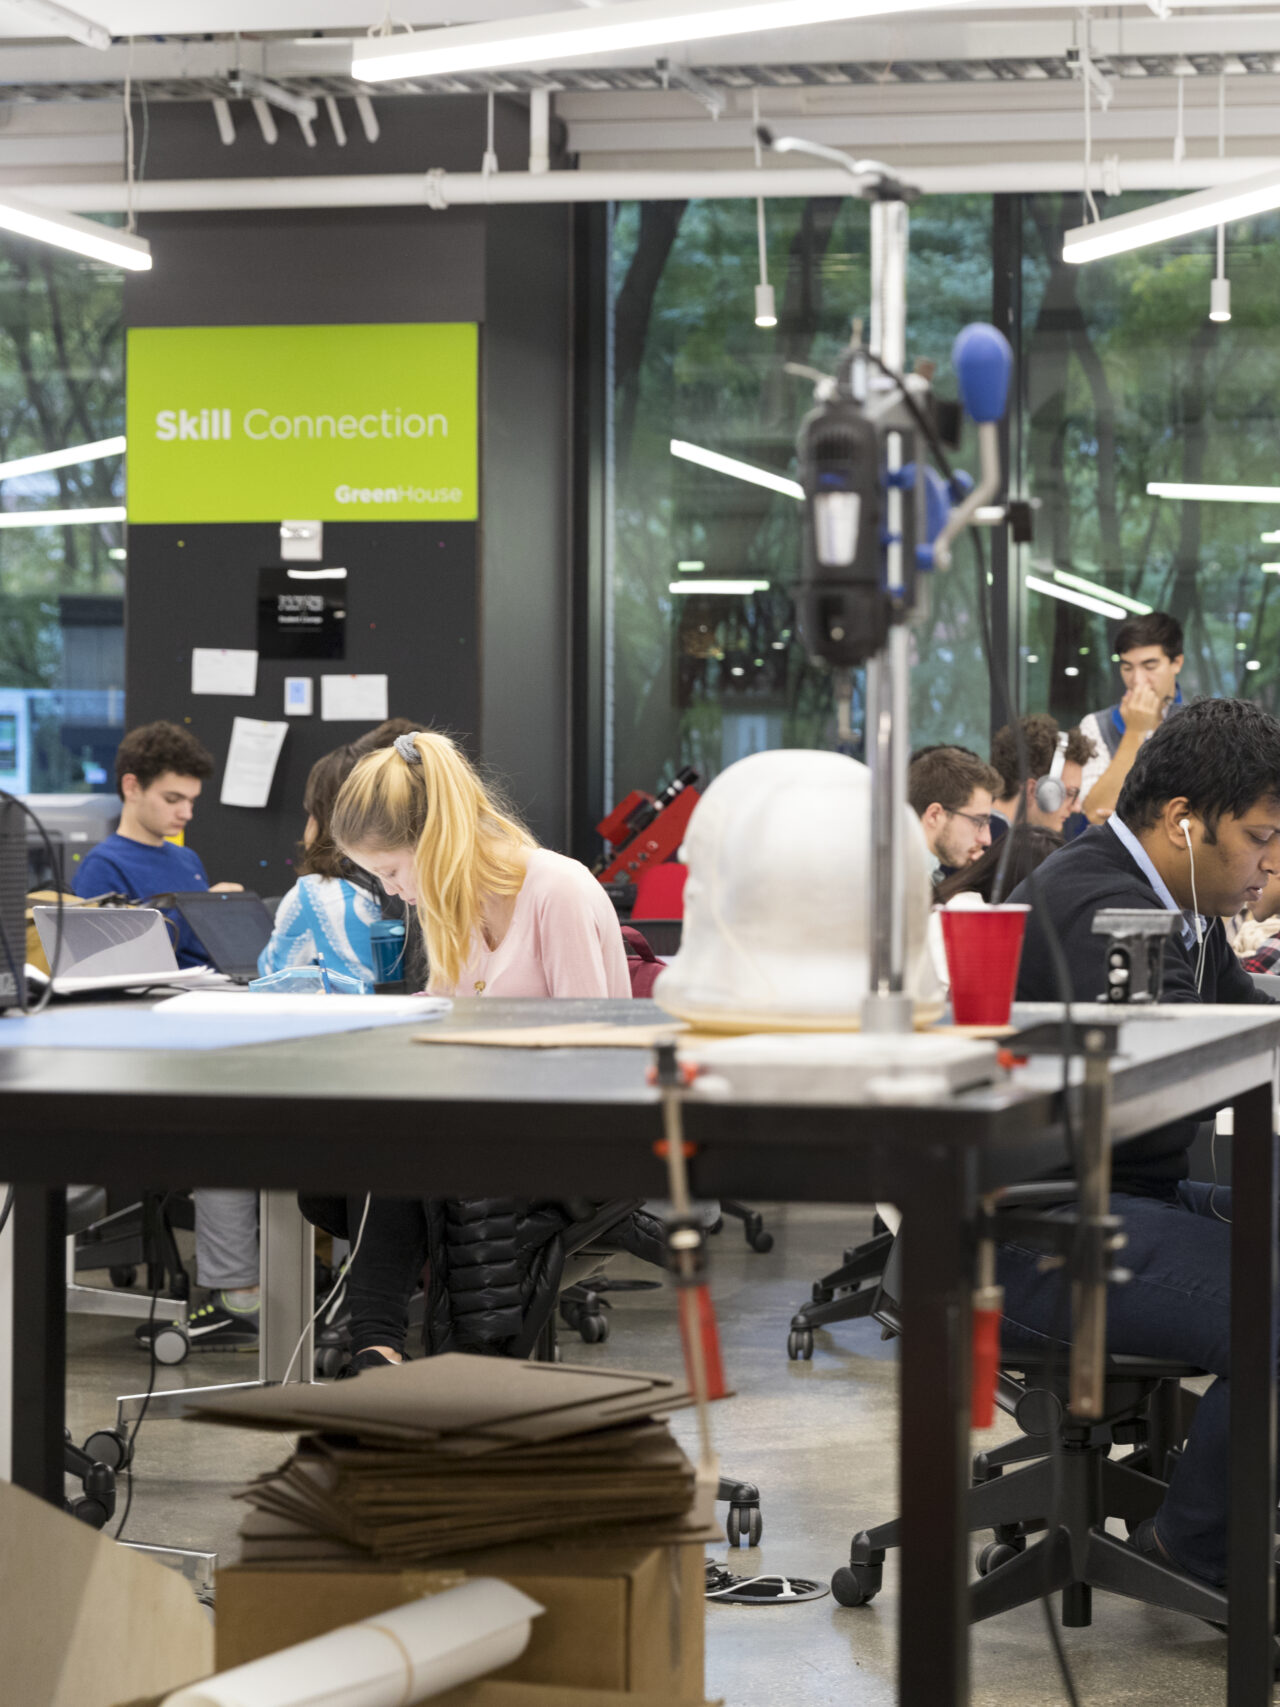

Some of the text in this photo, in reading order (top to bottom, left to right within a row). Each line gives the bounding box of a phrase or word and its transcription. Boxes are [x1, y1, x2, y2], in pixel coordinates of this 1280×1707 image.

[155, 407, 449, 441] Skill Connection
[334, 484, 463, 503] GreenHouse
